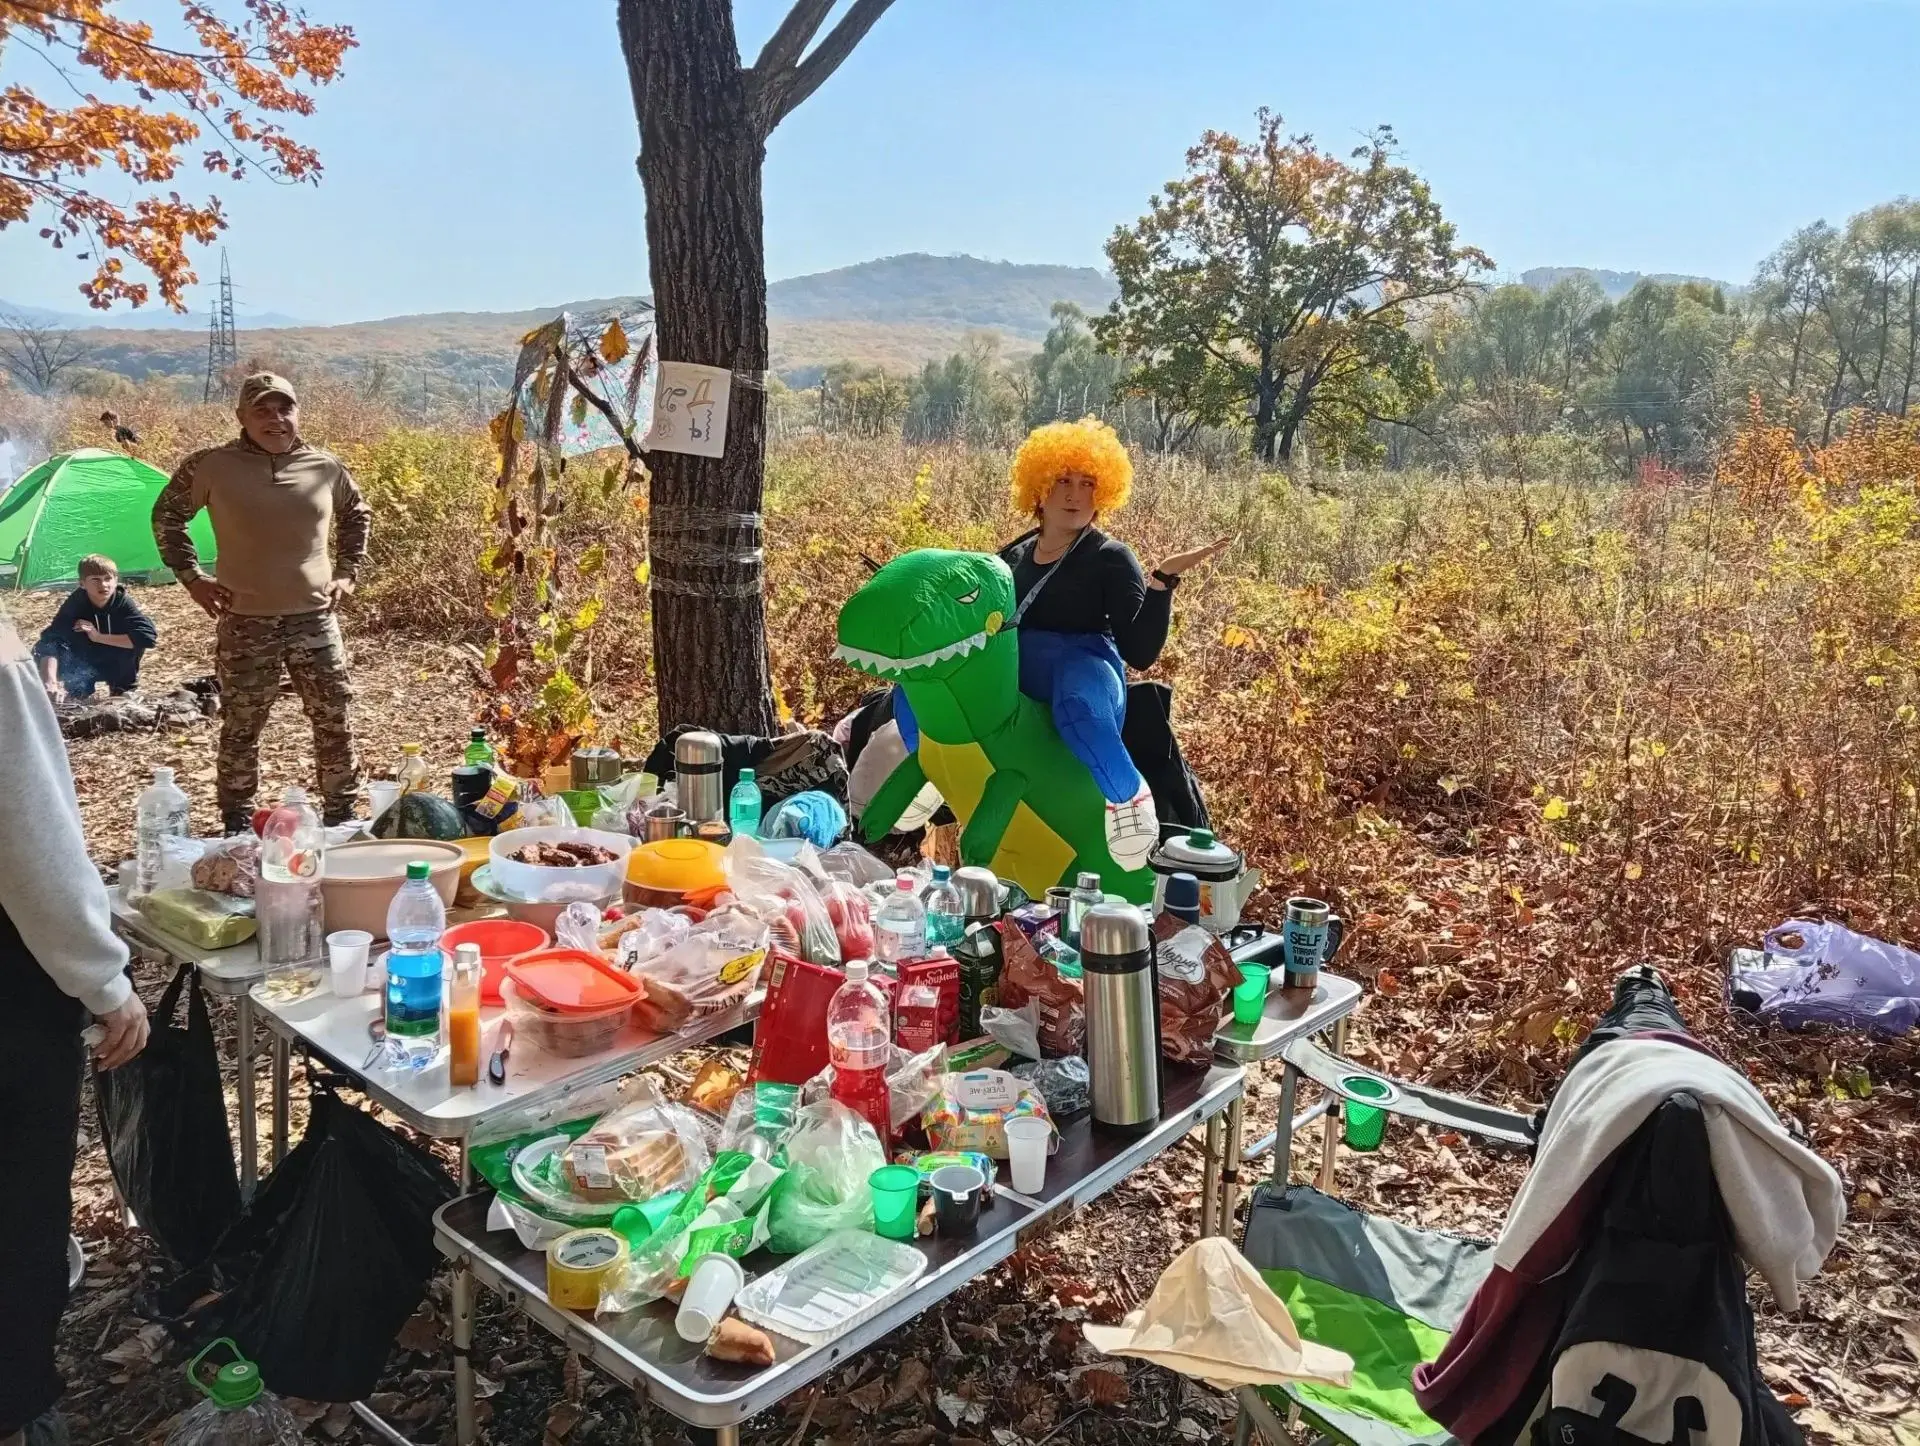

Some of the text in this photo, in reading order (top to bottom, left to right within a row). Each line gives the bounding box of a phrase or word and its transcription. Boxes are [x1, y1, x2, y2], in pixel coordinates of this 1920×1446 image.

[1290, 931, 1322, 946] SELF
[1293, 955, 1314, 966] MUG
[914, 968, 959, 987] Любимый
